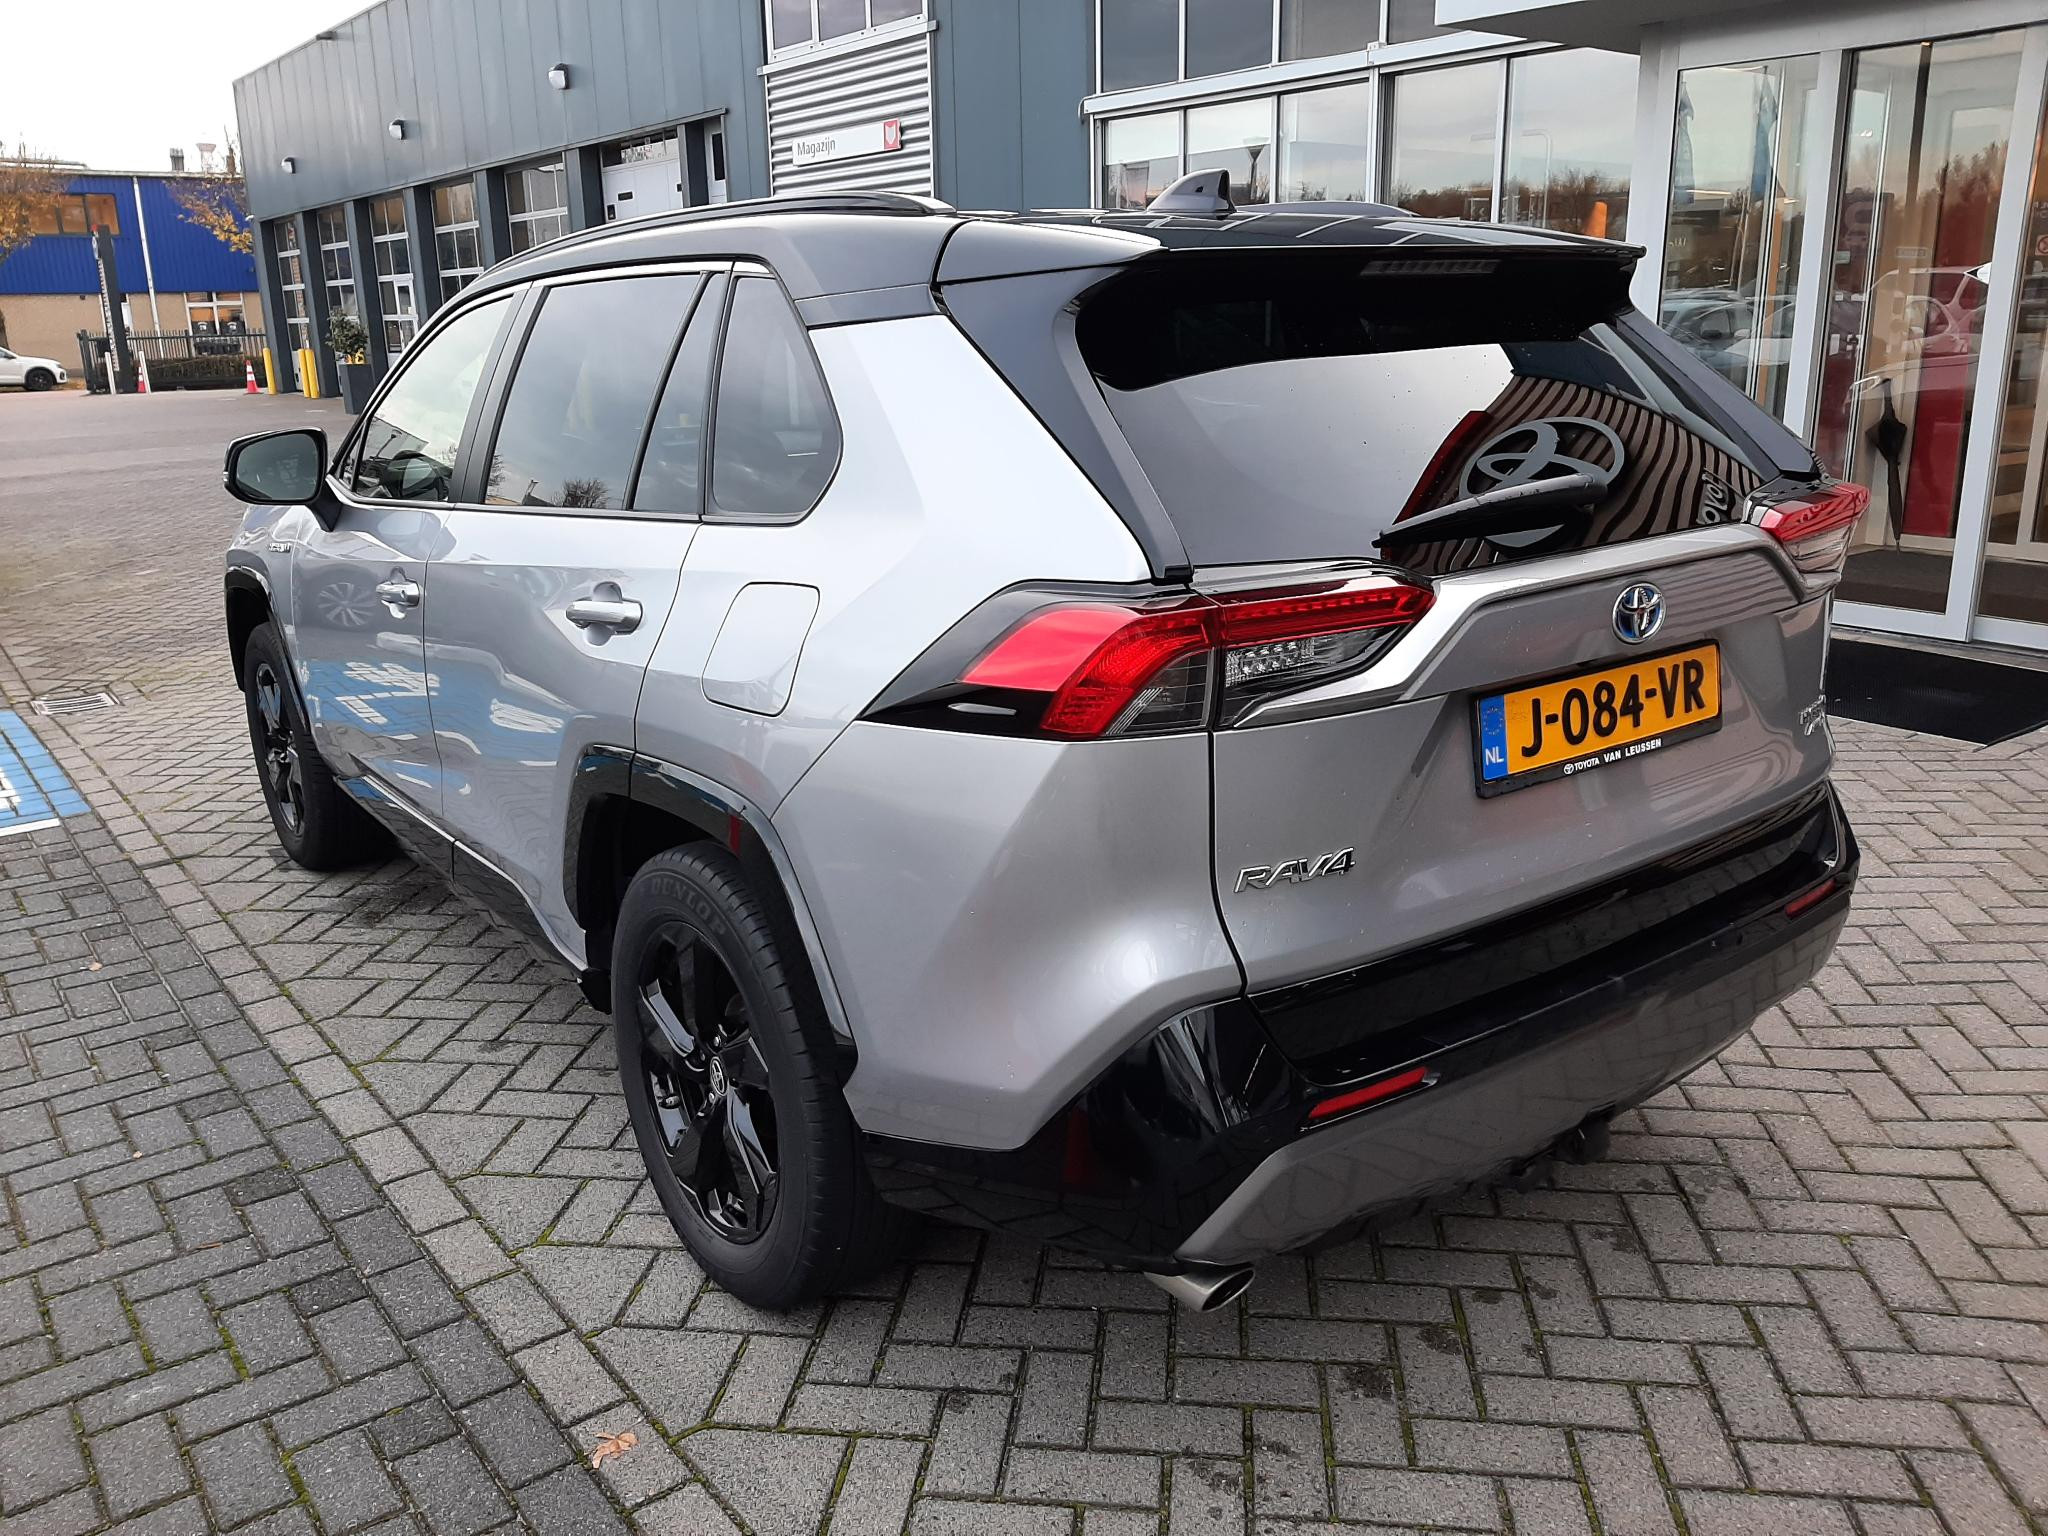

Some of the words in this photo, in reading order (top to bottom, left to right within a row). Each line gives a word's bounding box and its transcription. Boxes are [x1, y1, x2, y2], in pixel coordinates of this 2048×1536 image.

[796, 137, 836, 158] Magazijn
[1522, 659, 1705, 758] J-084-VR
[1485, 747, 1504, 766] NL
[1574, 757, 1600, 771] TOYOTA
[1603, 750, 1621, 763] VAN
[1625, 738, 1662, 757] LEUSSEN
[1233, 847, 1356, 893] RAV4
[651, 877, 727, 935] DUNLOP
